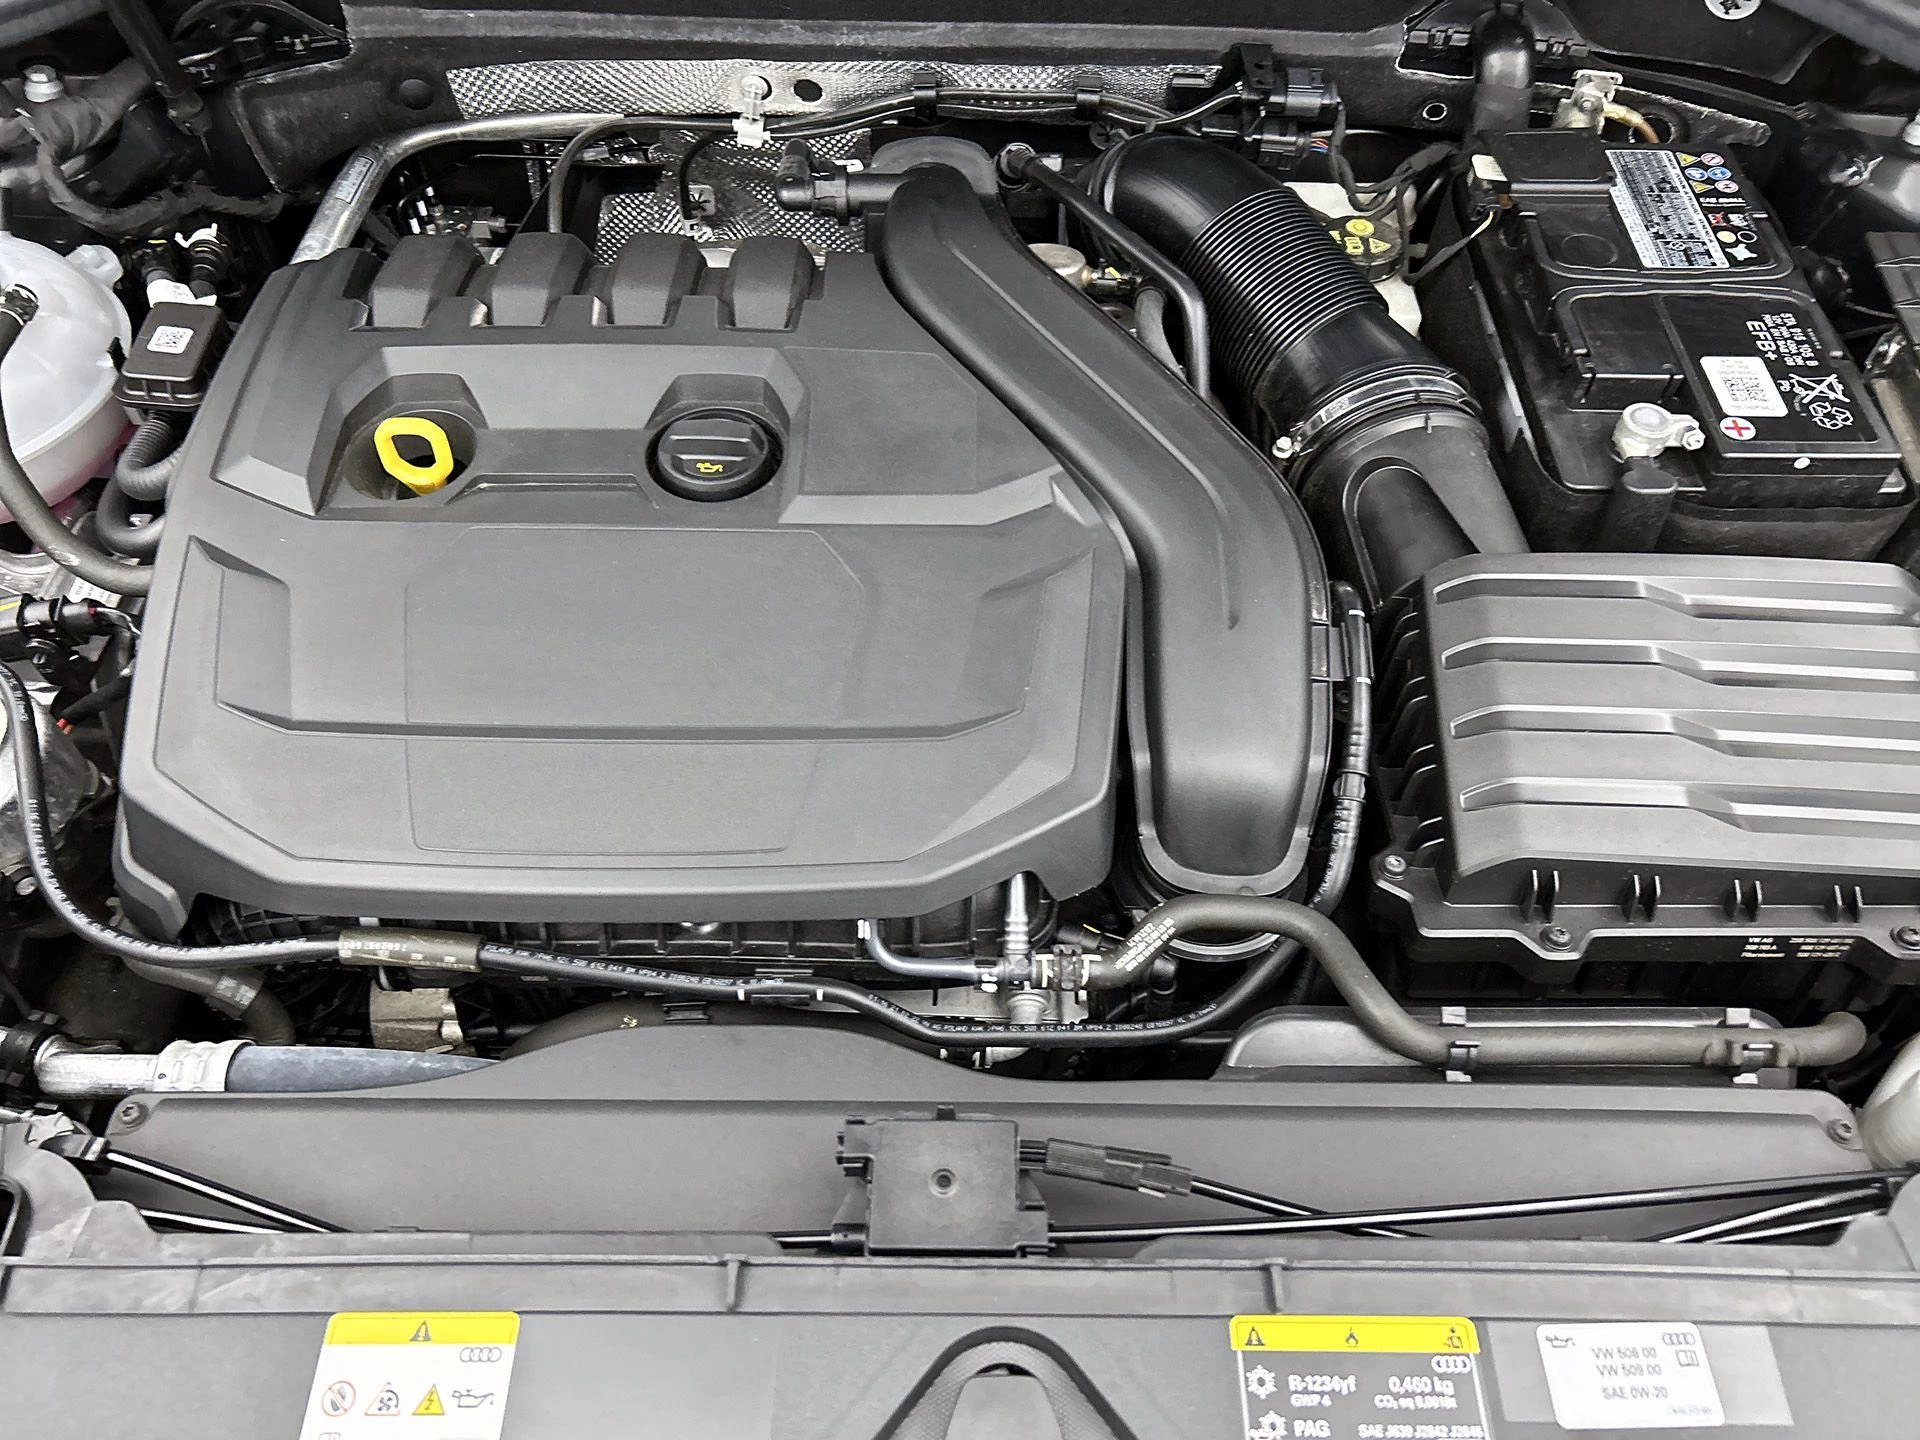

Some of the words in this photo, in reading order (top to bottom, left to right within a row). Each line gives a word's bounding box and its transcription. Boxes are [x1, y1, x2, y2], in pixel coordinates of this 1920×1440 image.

[1746, 321, 1778, 360] EFB+
[1591, 1347, 1615, 1359] VW
[1617, 1347, 1639, 1359] 508
[1642, 1346, 1657, 1359] 00
[1596, 1364, 1617, 1376] VW
[1647, 1364, 1662, 1376] 00
[1288, 1374, 1357, 1396] R-1234yf
[1388, 1375, 1432, 1394] 0,460
[1433, 1375, 1455, 1396] kg
[1603, 1386, 1627, 1399] SAE
[1631, 1386, 1669, 1399] 0W-20
[1293, 1419, 1331, 1438] PAG
